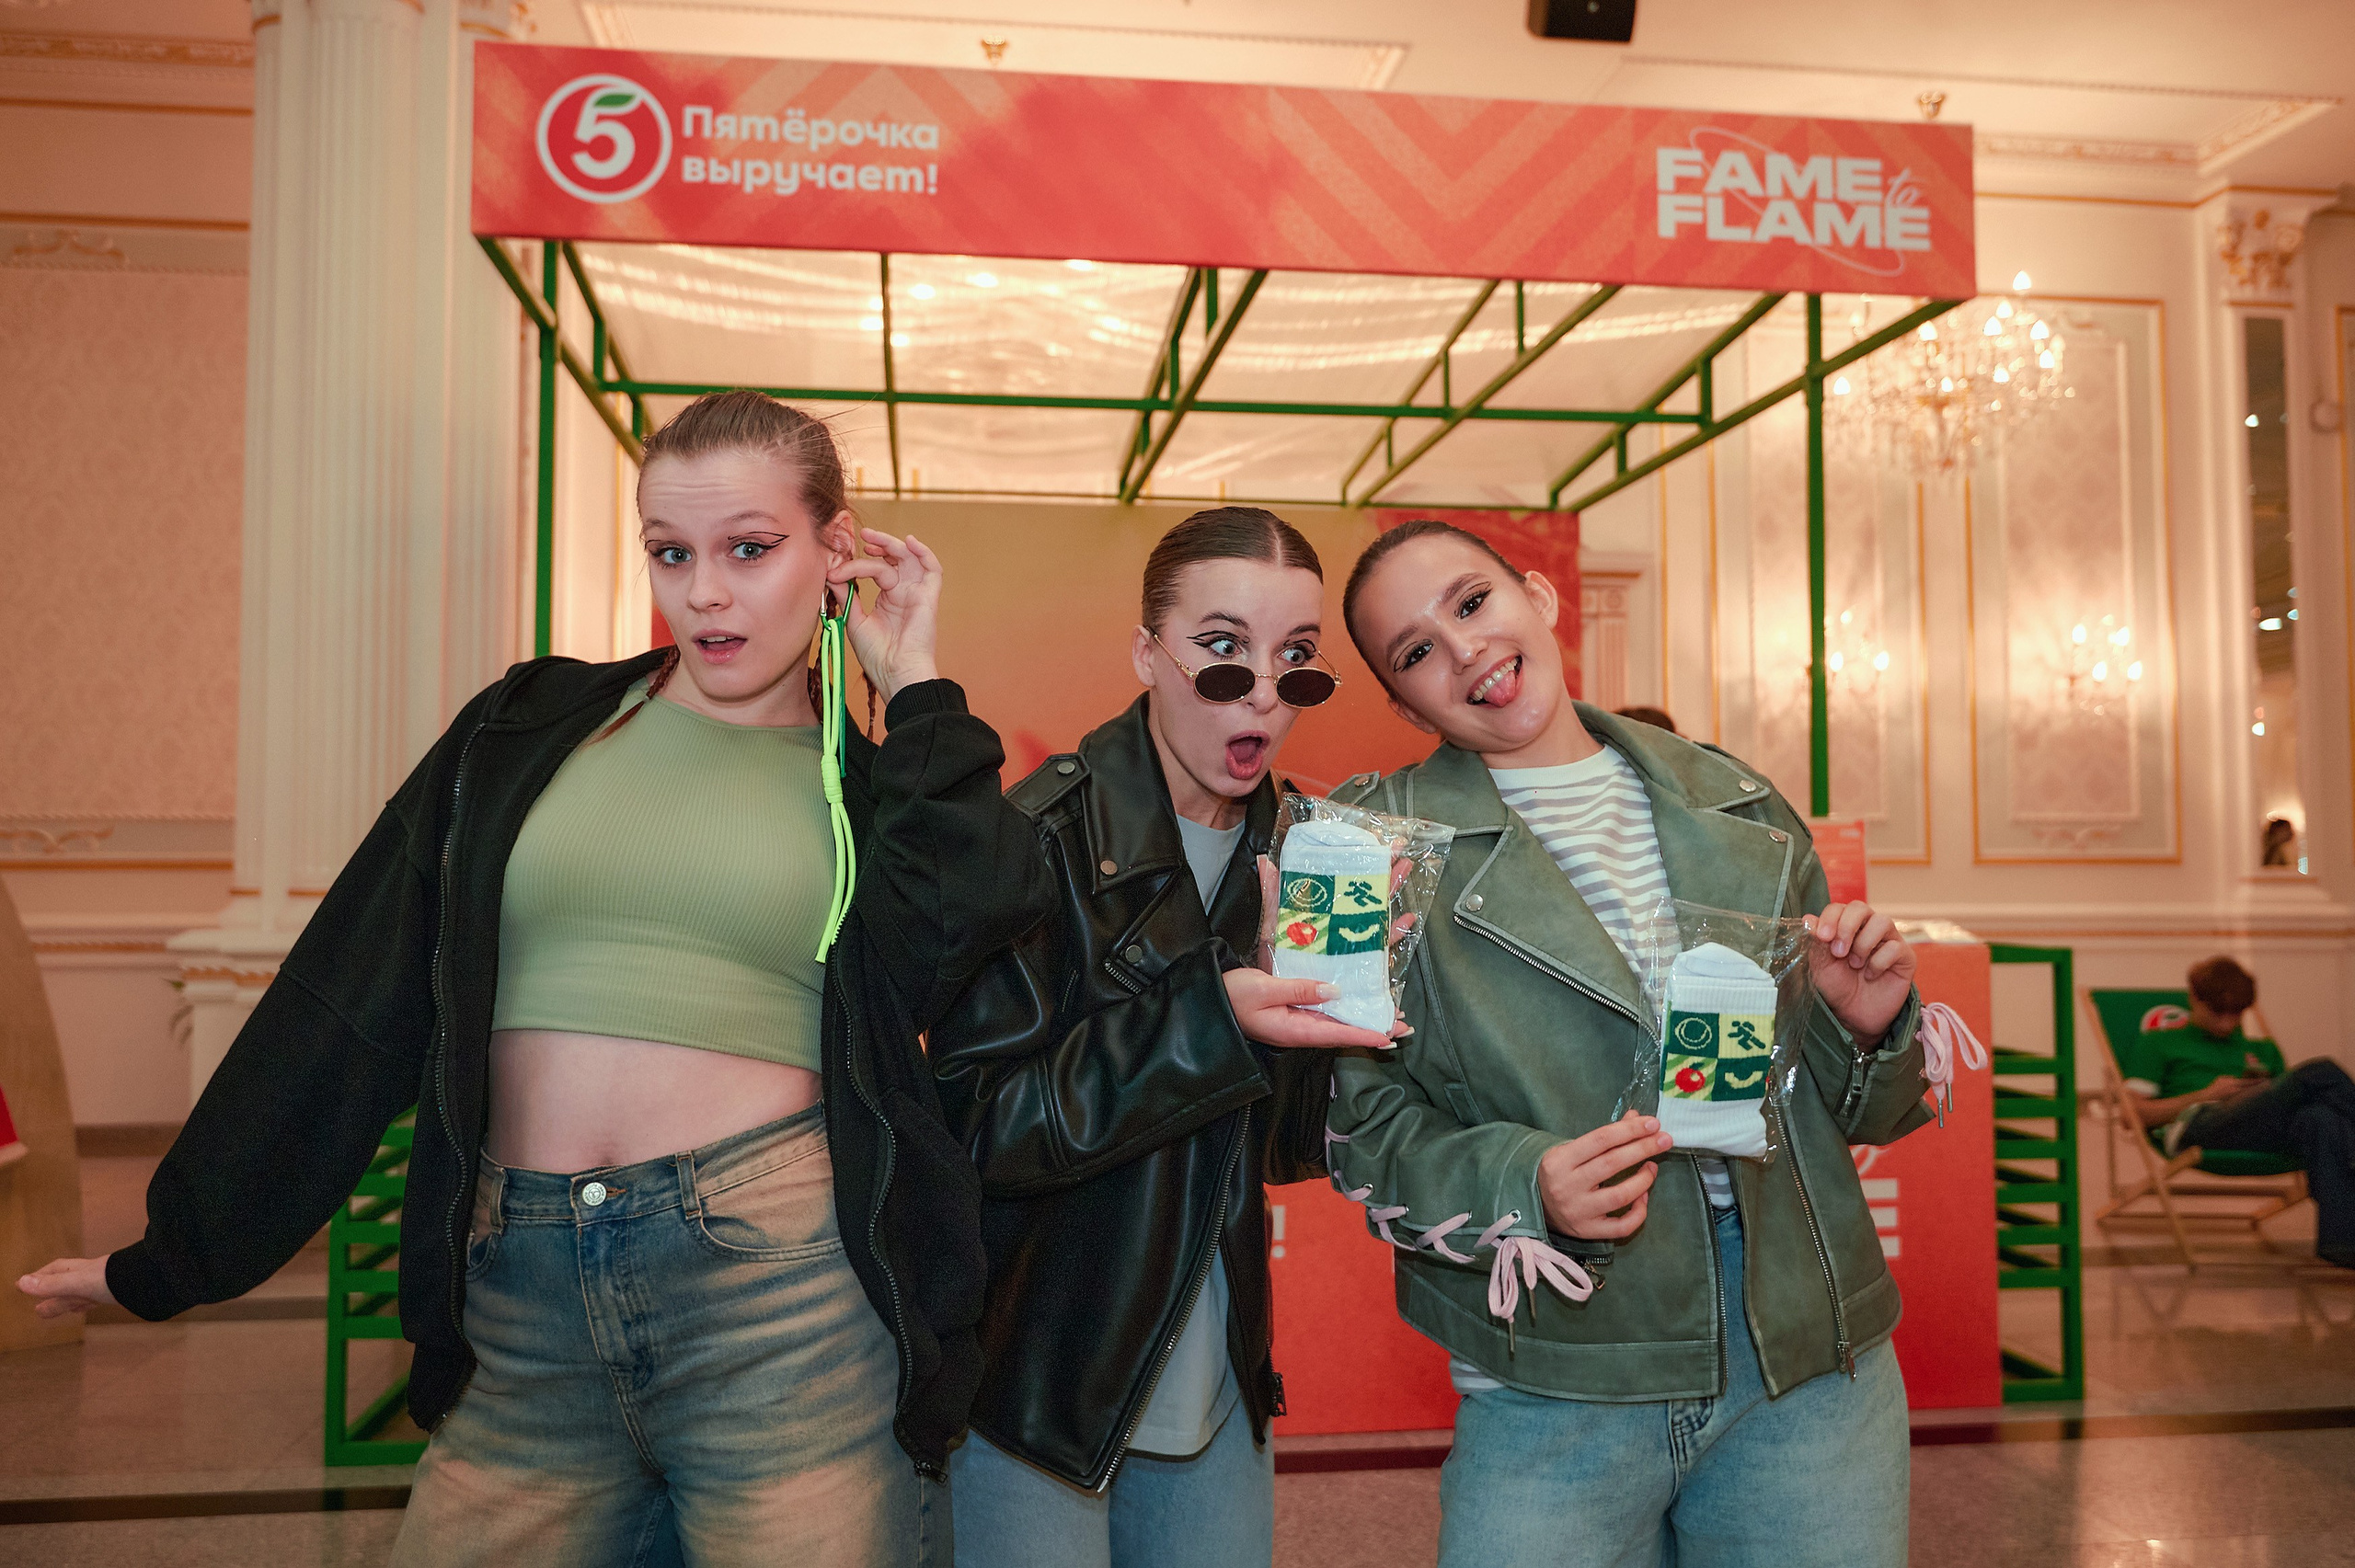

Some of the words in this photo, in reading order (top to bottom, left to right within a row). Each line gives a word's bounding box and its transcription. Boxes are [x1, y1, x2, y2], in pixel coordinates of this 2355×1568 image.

[571, 86, 642, 179] 5
[683, 106, 939, 150] Пятёрочка
[683, 157, 938, 195] выручает!
[1657, 147, 1883, 201] FAME
[1658, 193, 1931, 252] FLAME
